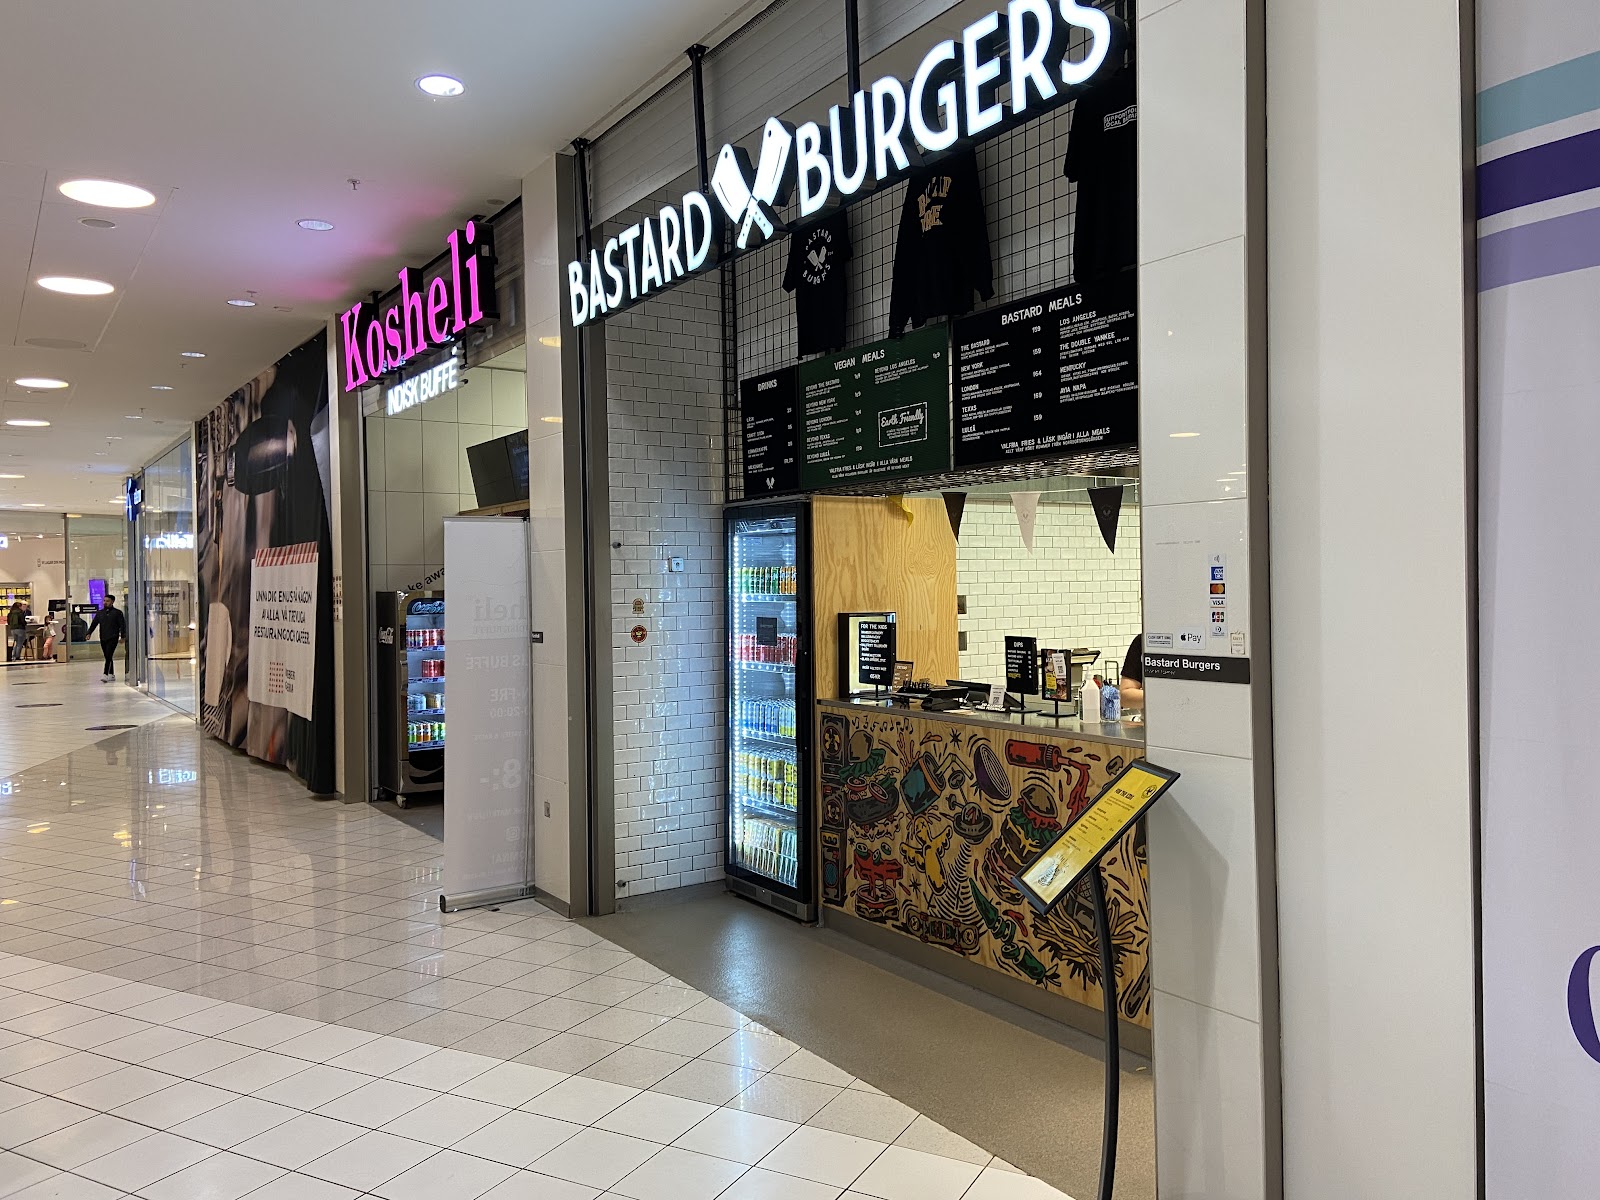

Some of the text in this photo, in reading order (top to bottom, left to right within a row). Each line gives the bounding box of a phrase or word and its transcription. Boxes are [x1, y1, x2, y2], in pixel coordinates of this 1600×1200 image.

[568, 0, 1111, 327] BASTARD BURGERS
[340, 220, 483, 393] Kosheli
[1001, 293, 1083, 326] BASTARD MEALS
[1060, 310, 1097, 327] LOS ANGELES
[1060, 331, 1116, 351] THE DOUBLE YANKEE
[834, 349, 886, 371] VEGAN MEALS
[757, 379, 778, 391] DRINKS
[387, 376, 419, 416] INDISK
[881, 407, 925, 428] Earth Friendly
[1076, 430, 1090, 439] ALLA
[1091, 427, 1111, 436] MEALS
[424, 567, 445, 585] awa
[1187, 633, 1202, 644] Pay
[1144, 656, 1220, 671] Bastard Burgers
